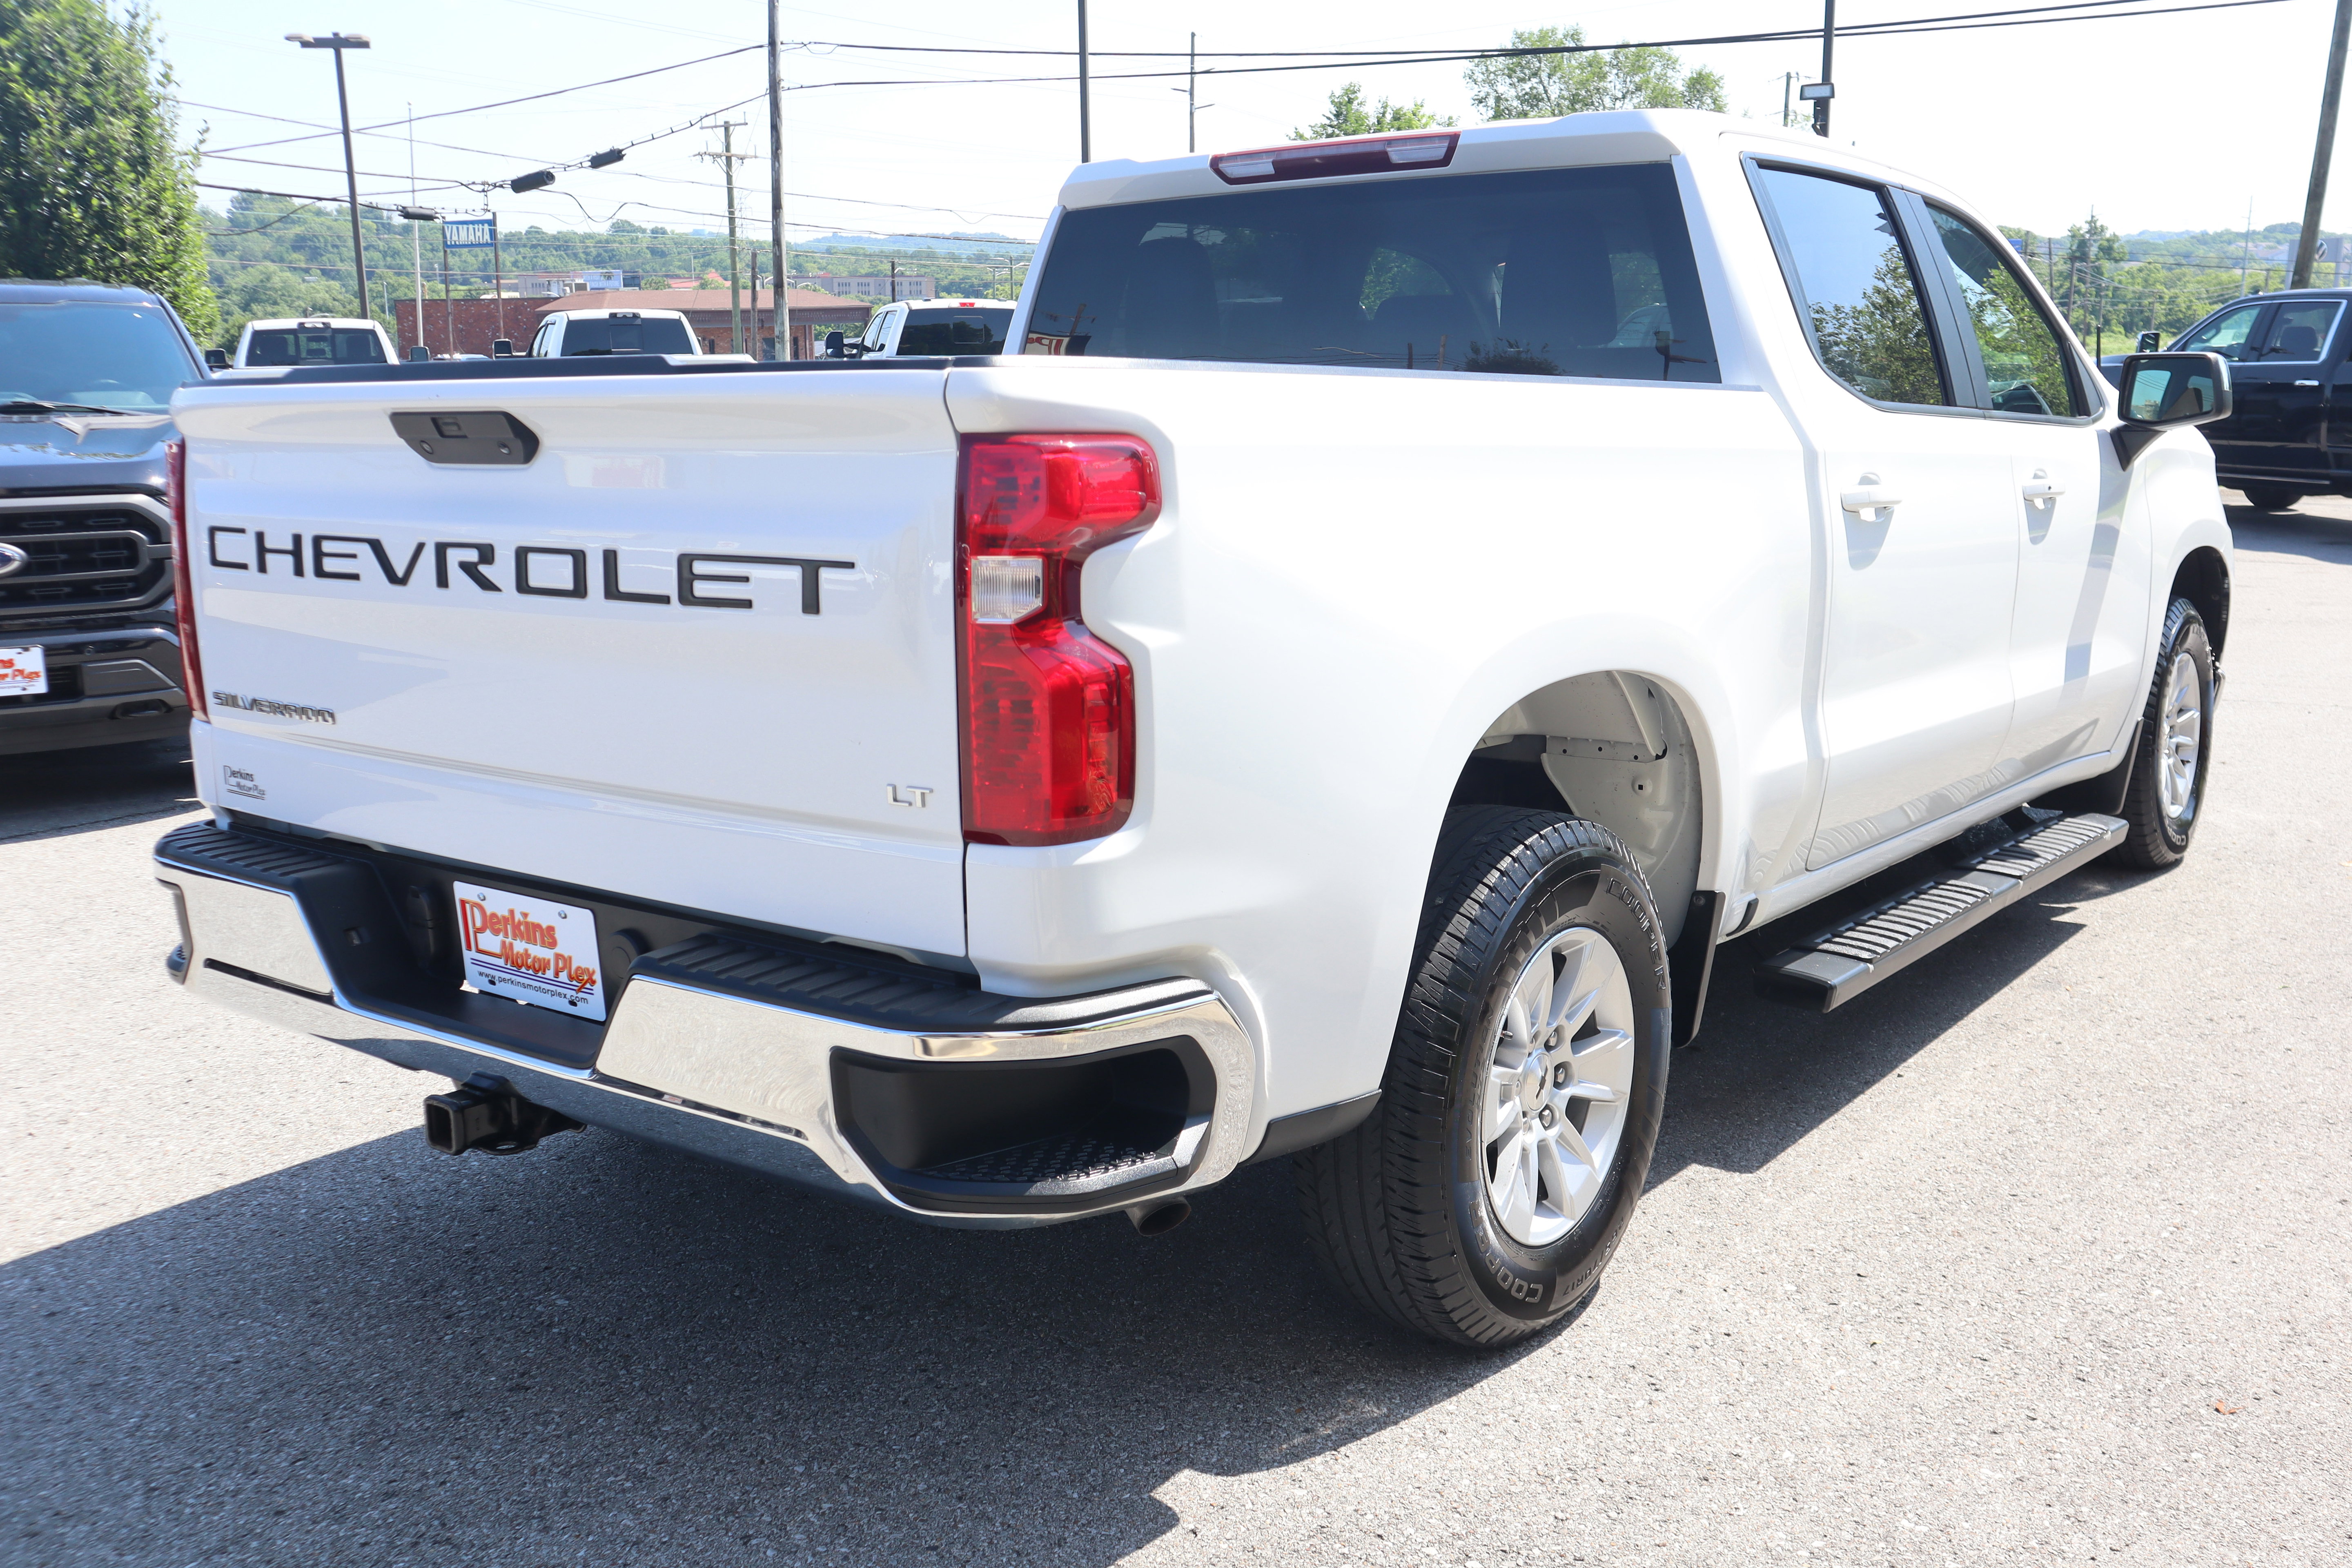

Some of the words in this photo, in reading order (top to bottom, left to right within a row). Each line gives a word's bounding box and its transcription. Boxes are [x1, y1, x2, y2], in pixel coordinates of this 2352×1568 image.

[444, 223, 490, 245] YAMAHA
[208, 526, 855, 615] CHEVROLET
[213, 690, 336, 725] SILVERADO
[223, 765, 254, 784] Perkins
[886, 783, 933, 808] LT
[459, 898, 558, 951] Perkins
[1606, 878, 1666, 992] COOPER
[477, 970, 588, 1004] www.perkinsmotorplex.com
[500, 938, 551, 975] Motor
[553, 951, 597, 993] Plex
[1470, 1201, 1544, 1303] COOPER
